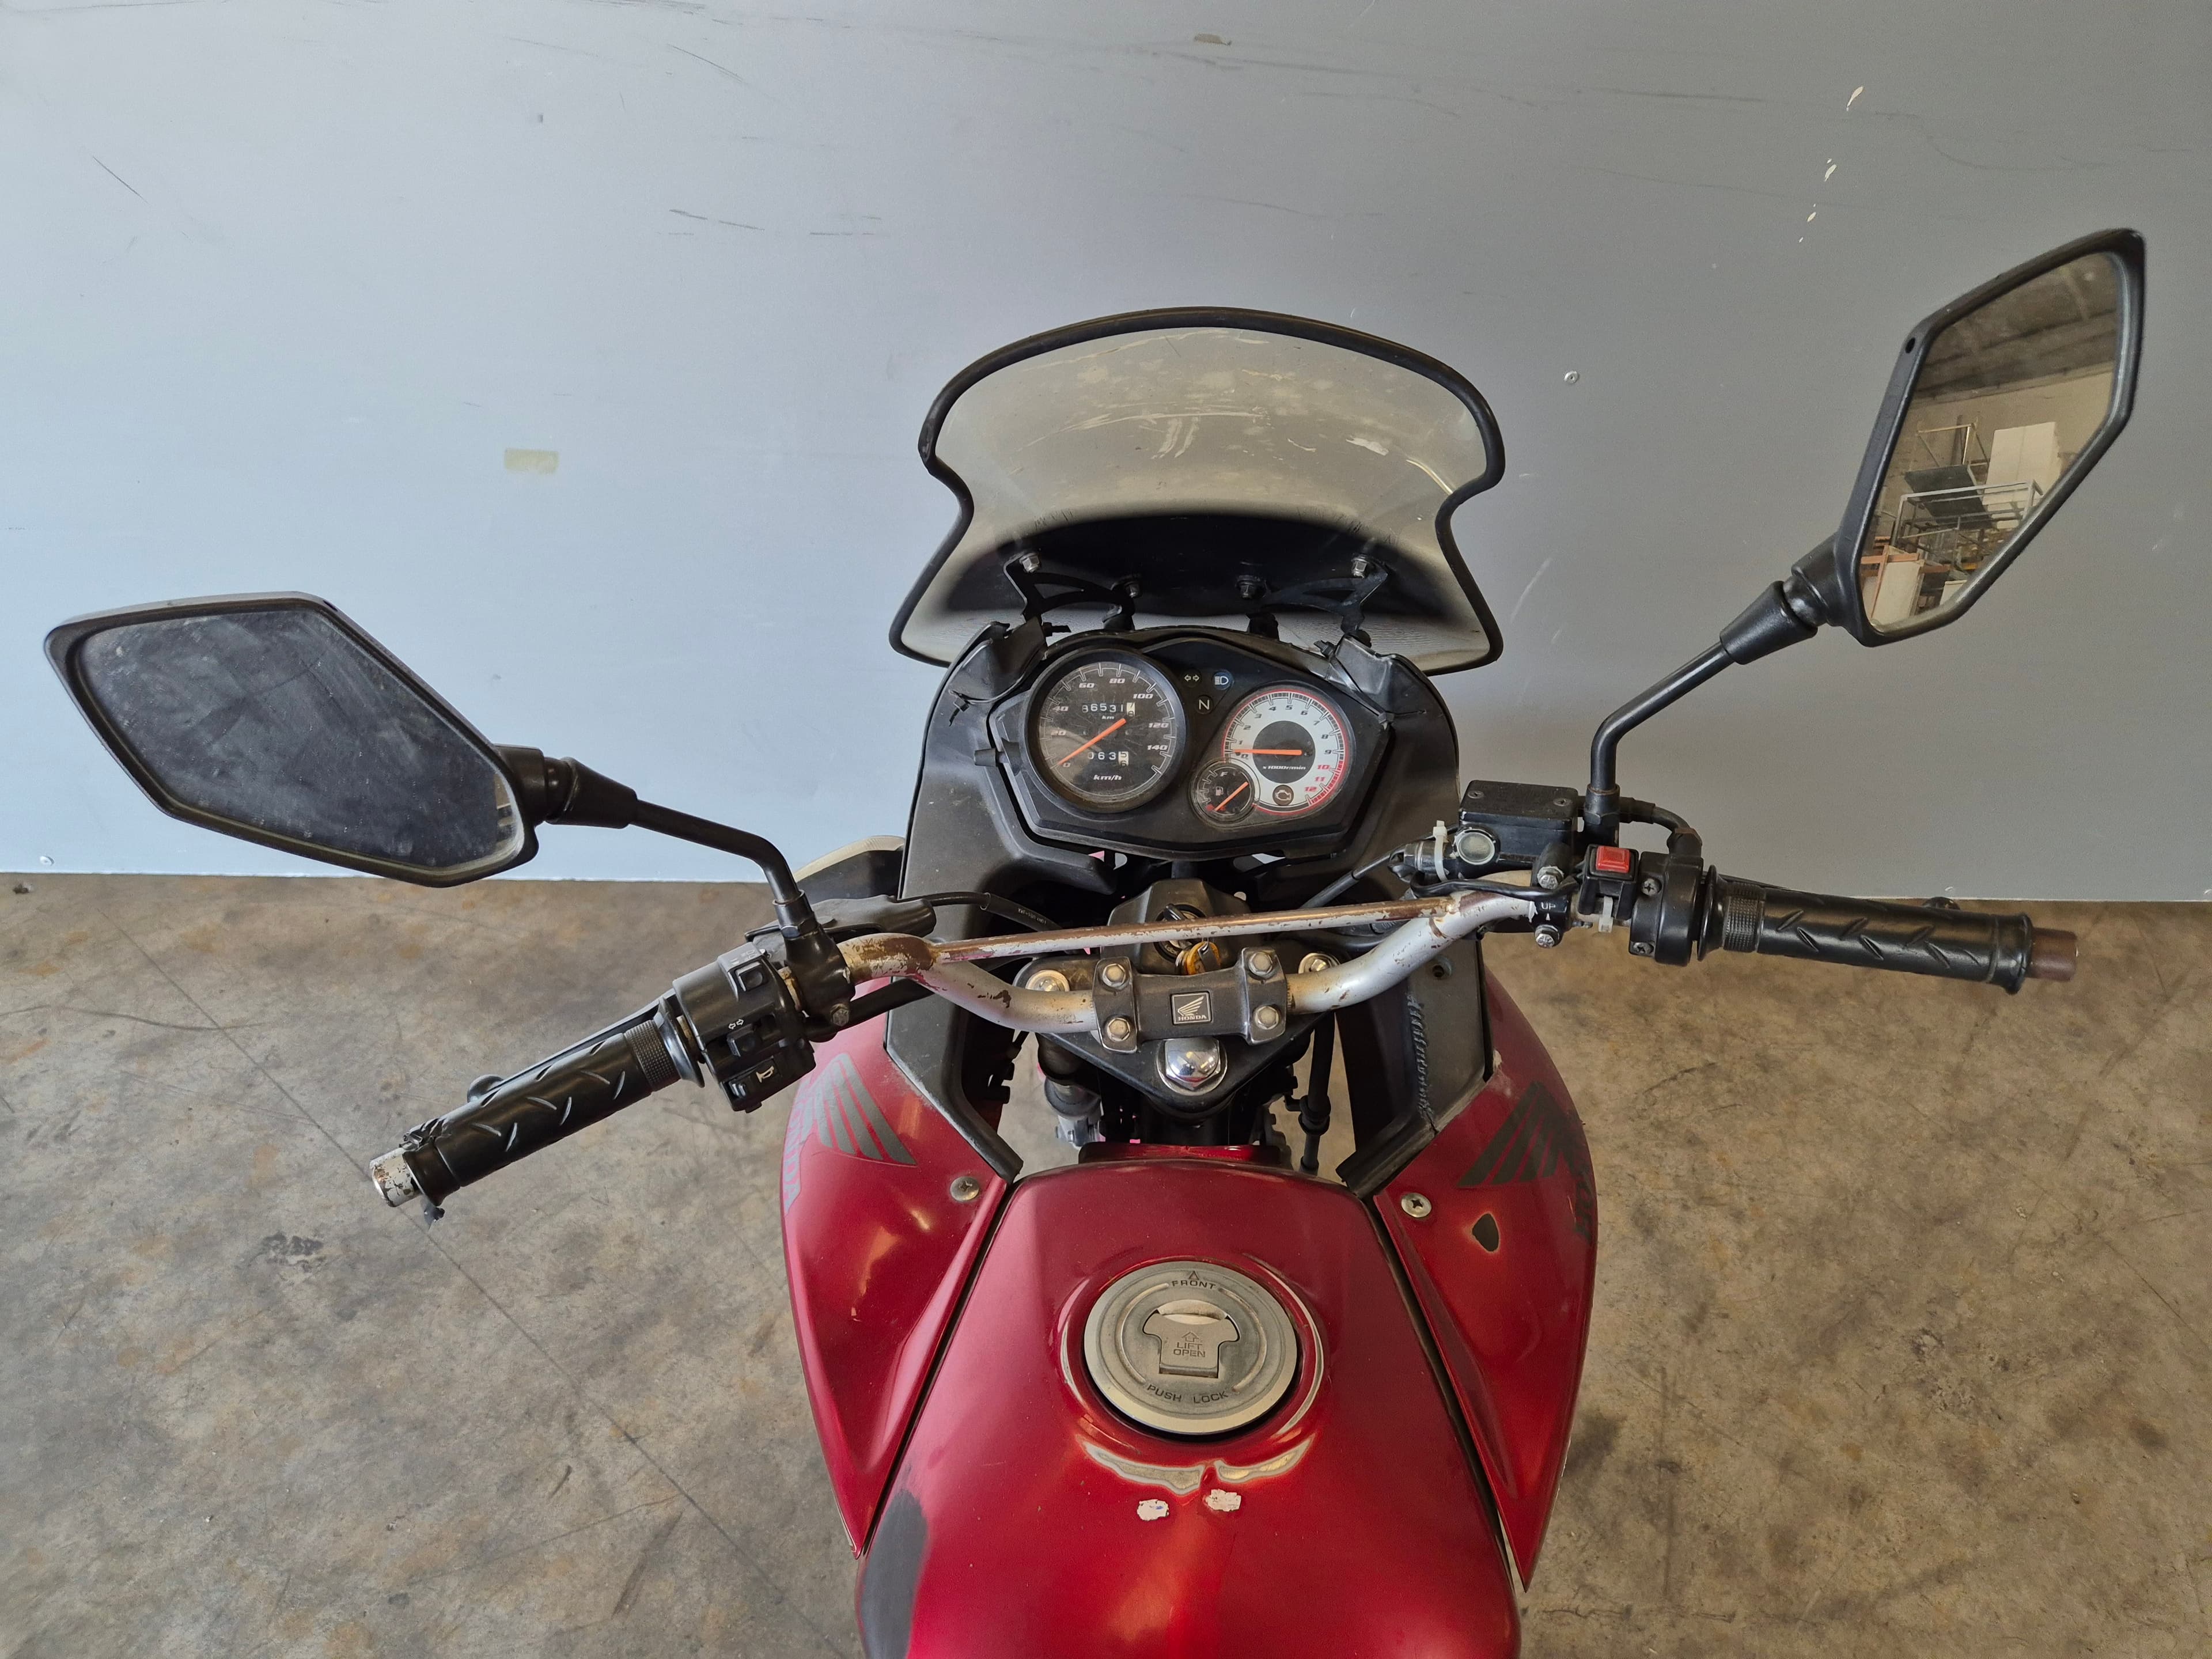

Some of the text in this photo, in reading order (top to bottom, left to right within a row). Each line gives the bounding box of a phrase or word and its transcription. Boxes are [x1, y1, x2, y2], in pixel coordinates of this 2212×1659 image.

[1199, 699, 1210, 710] N
[1541, 902, 1556, 910] UP
[1172, 1280, 1216, 1289] FRONT
[1177, 1342, 1202, 1350] LIFT
[1173, 1349, 1206, 1358] OPEN
[1147, 1384, 1228, 1404] PUSH LOCK
